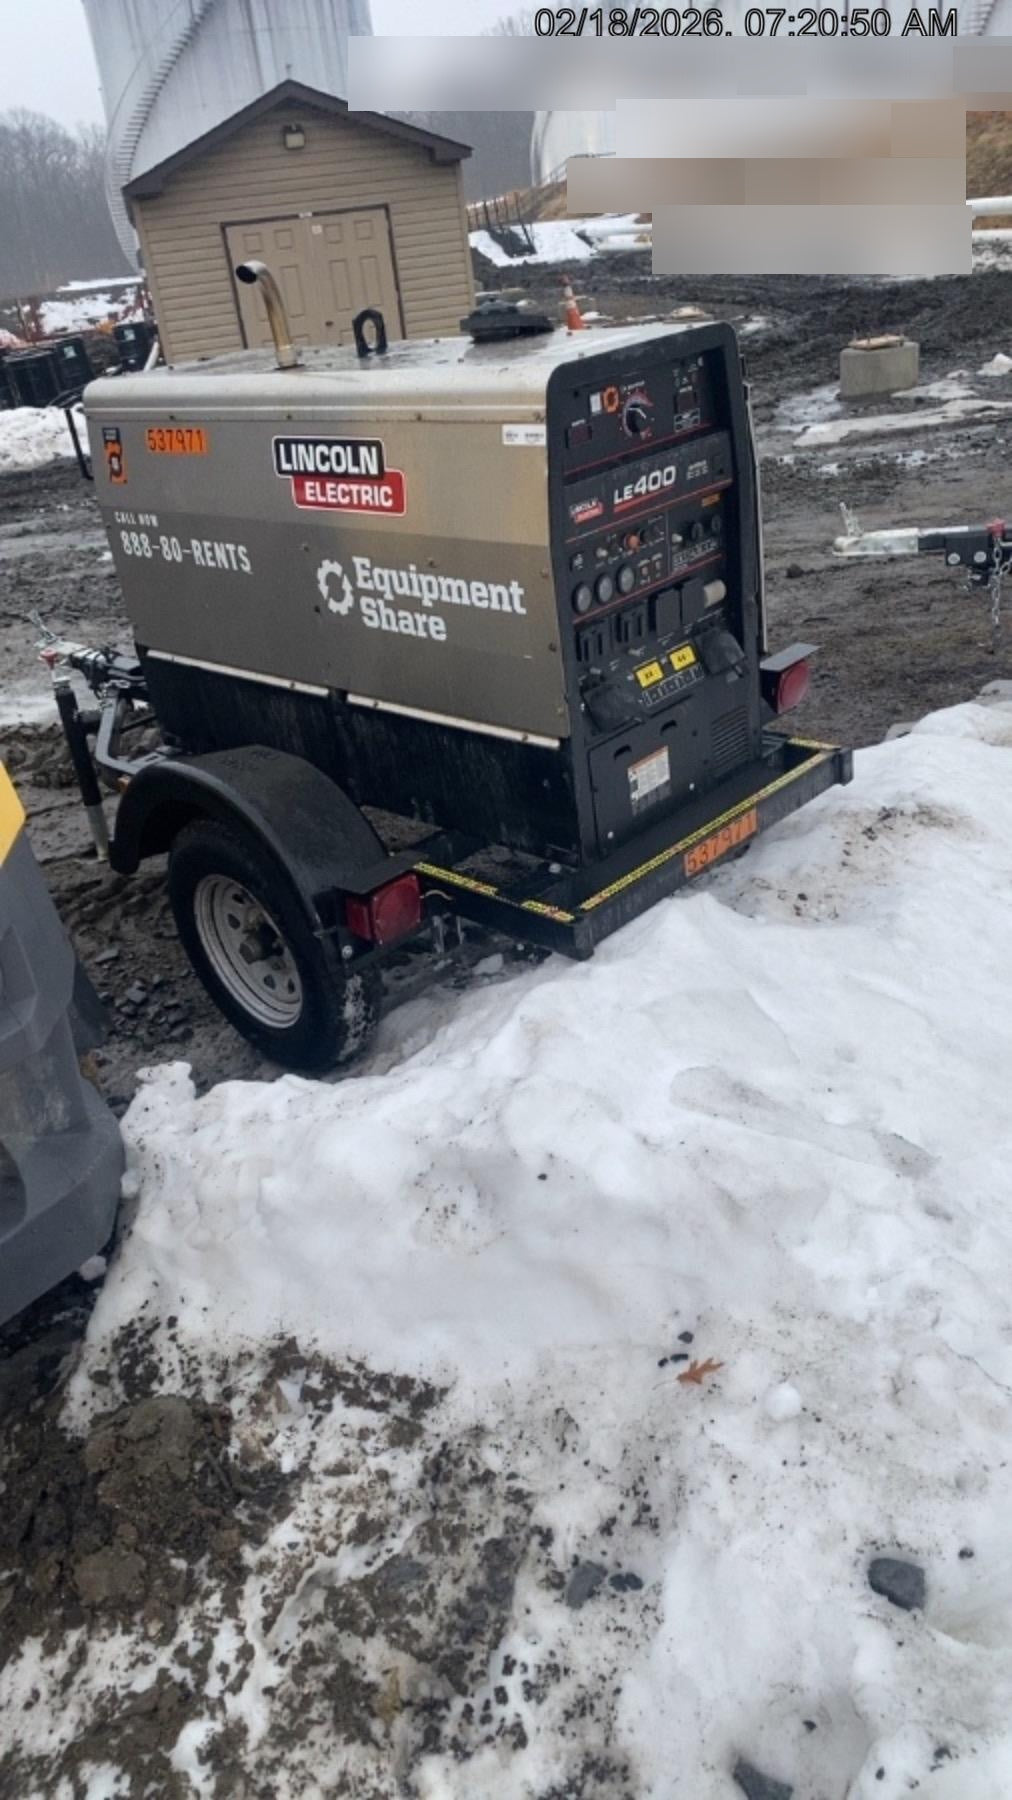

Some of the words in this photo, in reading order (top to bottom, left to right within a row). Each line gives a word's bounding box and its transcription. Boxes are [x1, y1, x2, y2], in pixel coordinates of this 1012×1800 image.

[147, 428, 205, 451] 537971
[279, 443, 379, 475] LINCOLN
[304, 481, 393, 507] ELECTRIC
[613, 465, 677, 504] LE400
[114, 511, 137, 525] CALL
[138, 513, 159, 528] NOW
[120, 530, 252, 574] 888-80-RENTS
[351, 555, 527, 615] Equipment
[359, 596, 447, 641] Share
[687, 812, 756, 873] 537971
